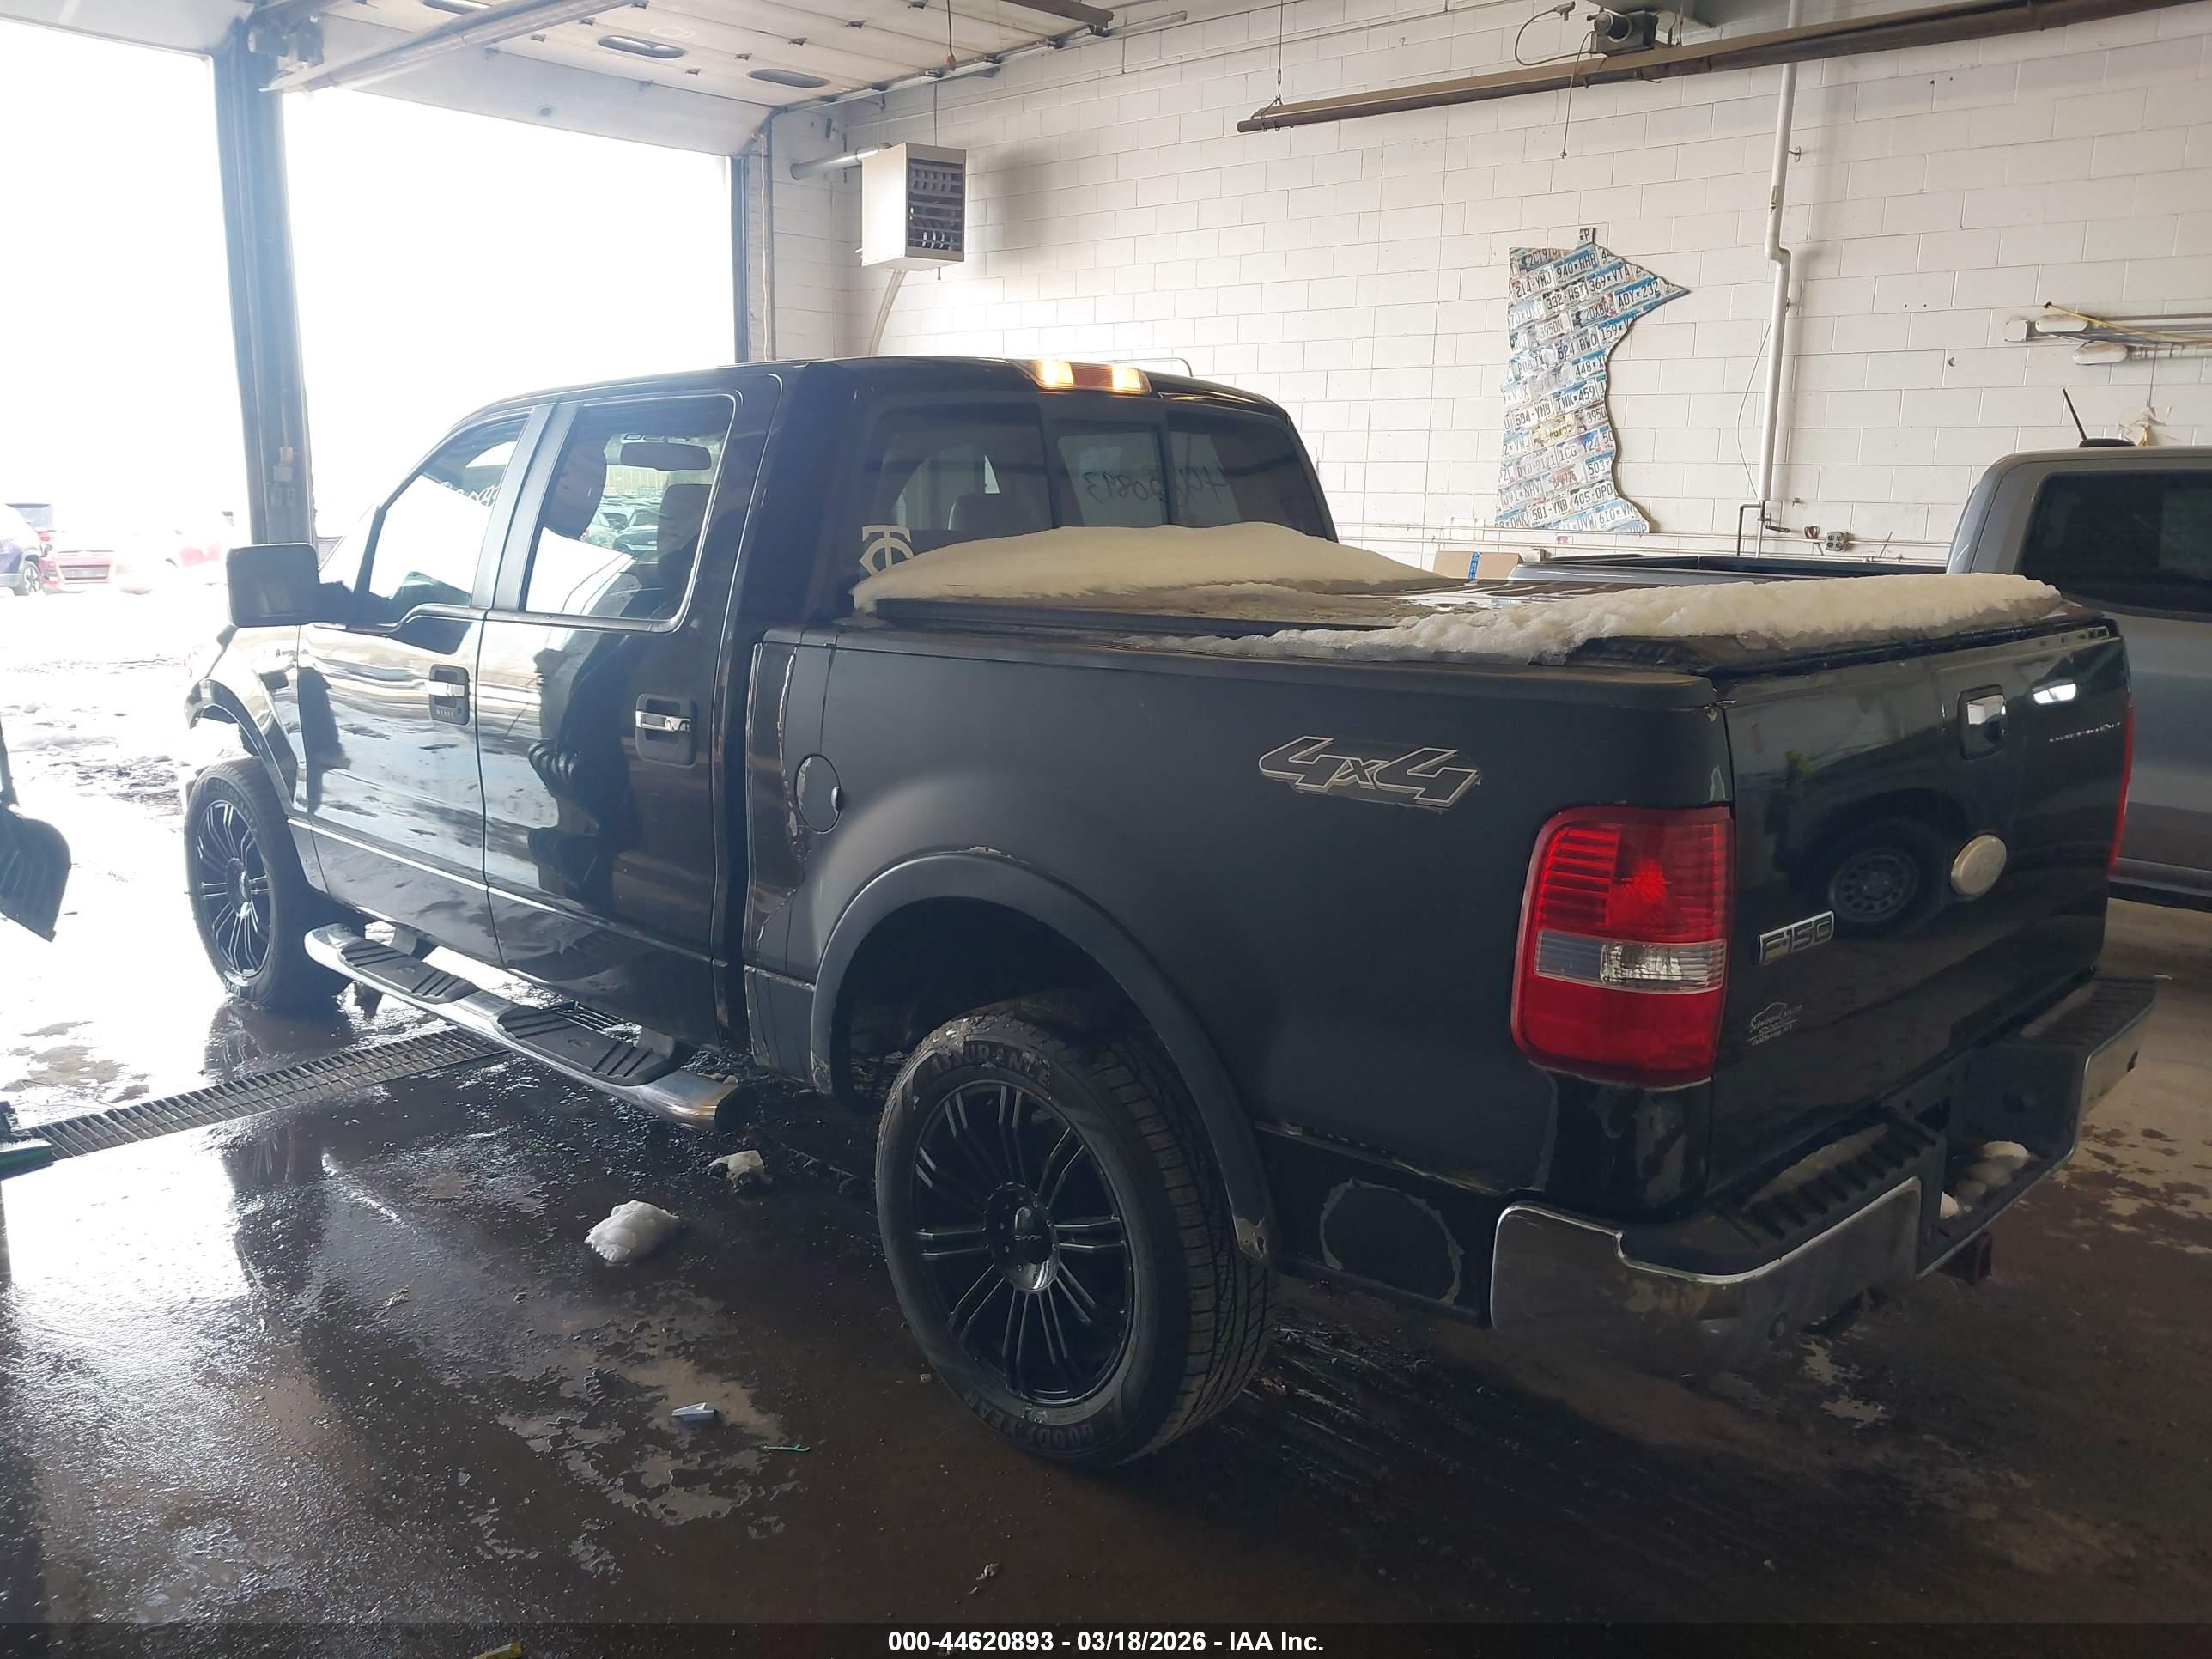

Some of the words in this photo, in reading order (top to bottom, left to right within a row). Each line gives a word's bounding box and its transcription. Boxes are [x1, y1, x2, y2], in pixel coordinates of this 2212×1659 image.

[1557, 263, 1574, 280] 940
[1579, 252, 1597, 270] RHR
[1589, 275, 1606, 293] 369
[1611, 264, 1631, 282] VTA
[1618, 290, 1635, 308] ADY
[1641, 281, 1659, 299] 232
[1601, 324, 1618, 341] 159
[1575, 360, 1592, 377] 448
[1578, 385, 1595, 404] 459
[1599, 508, 1615, 525] 610
